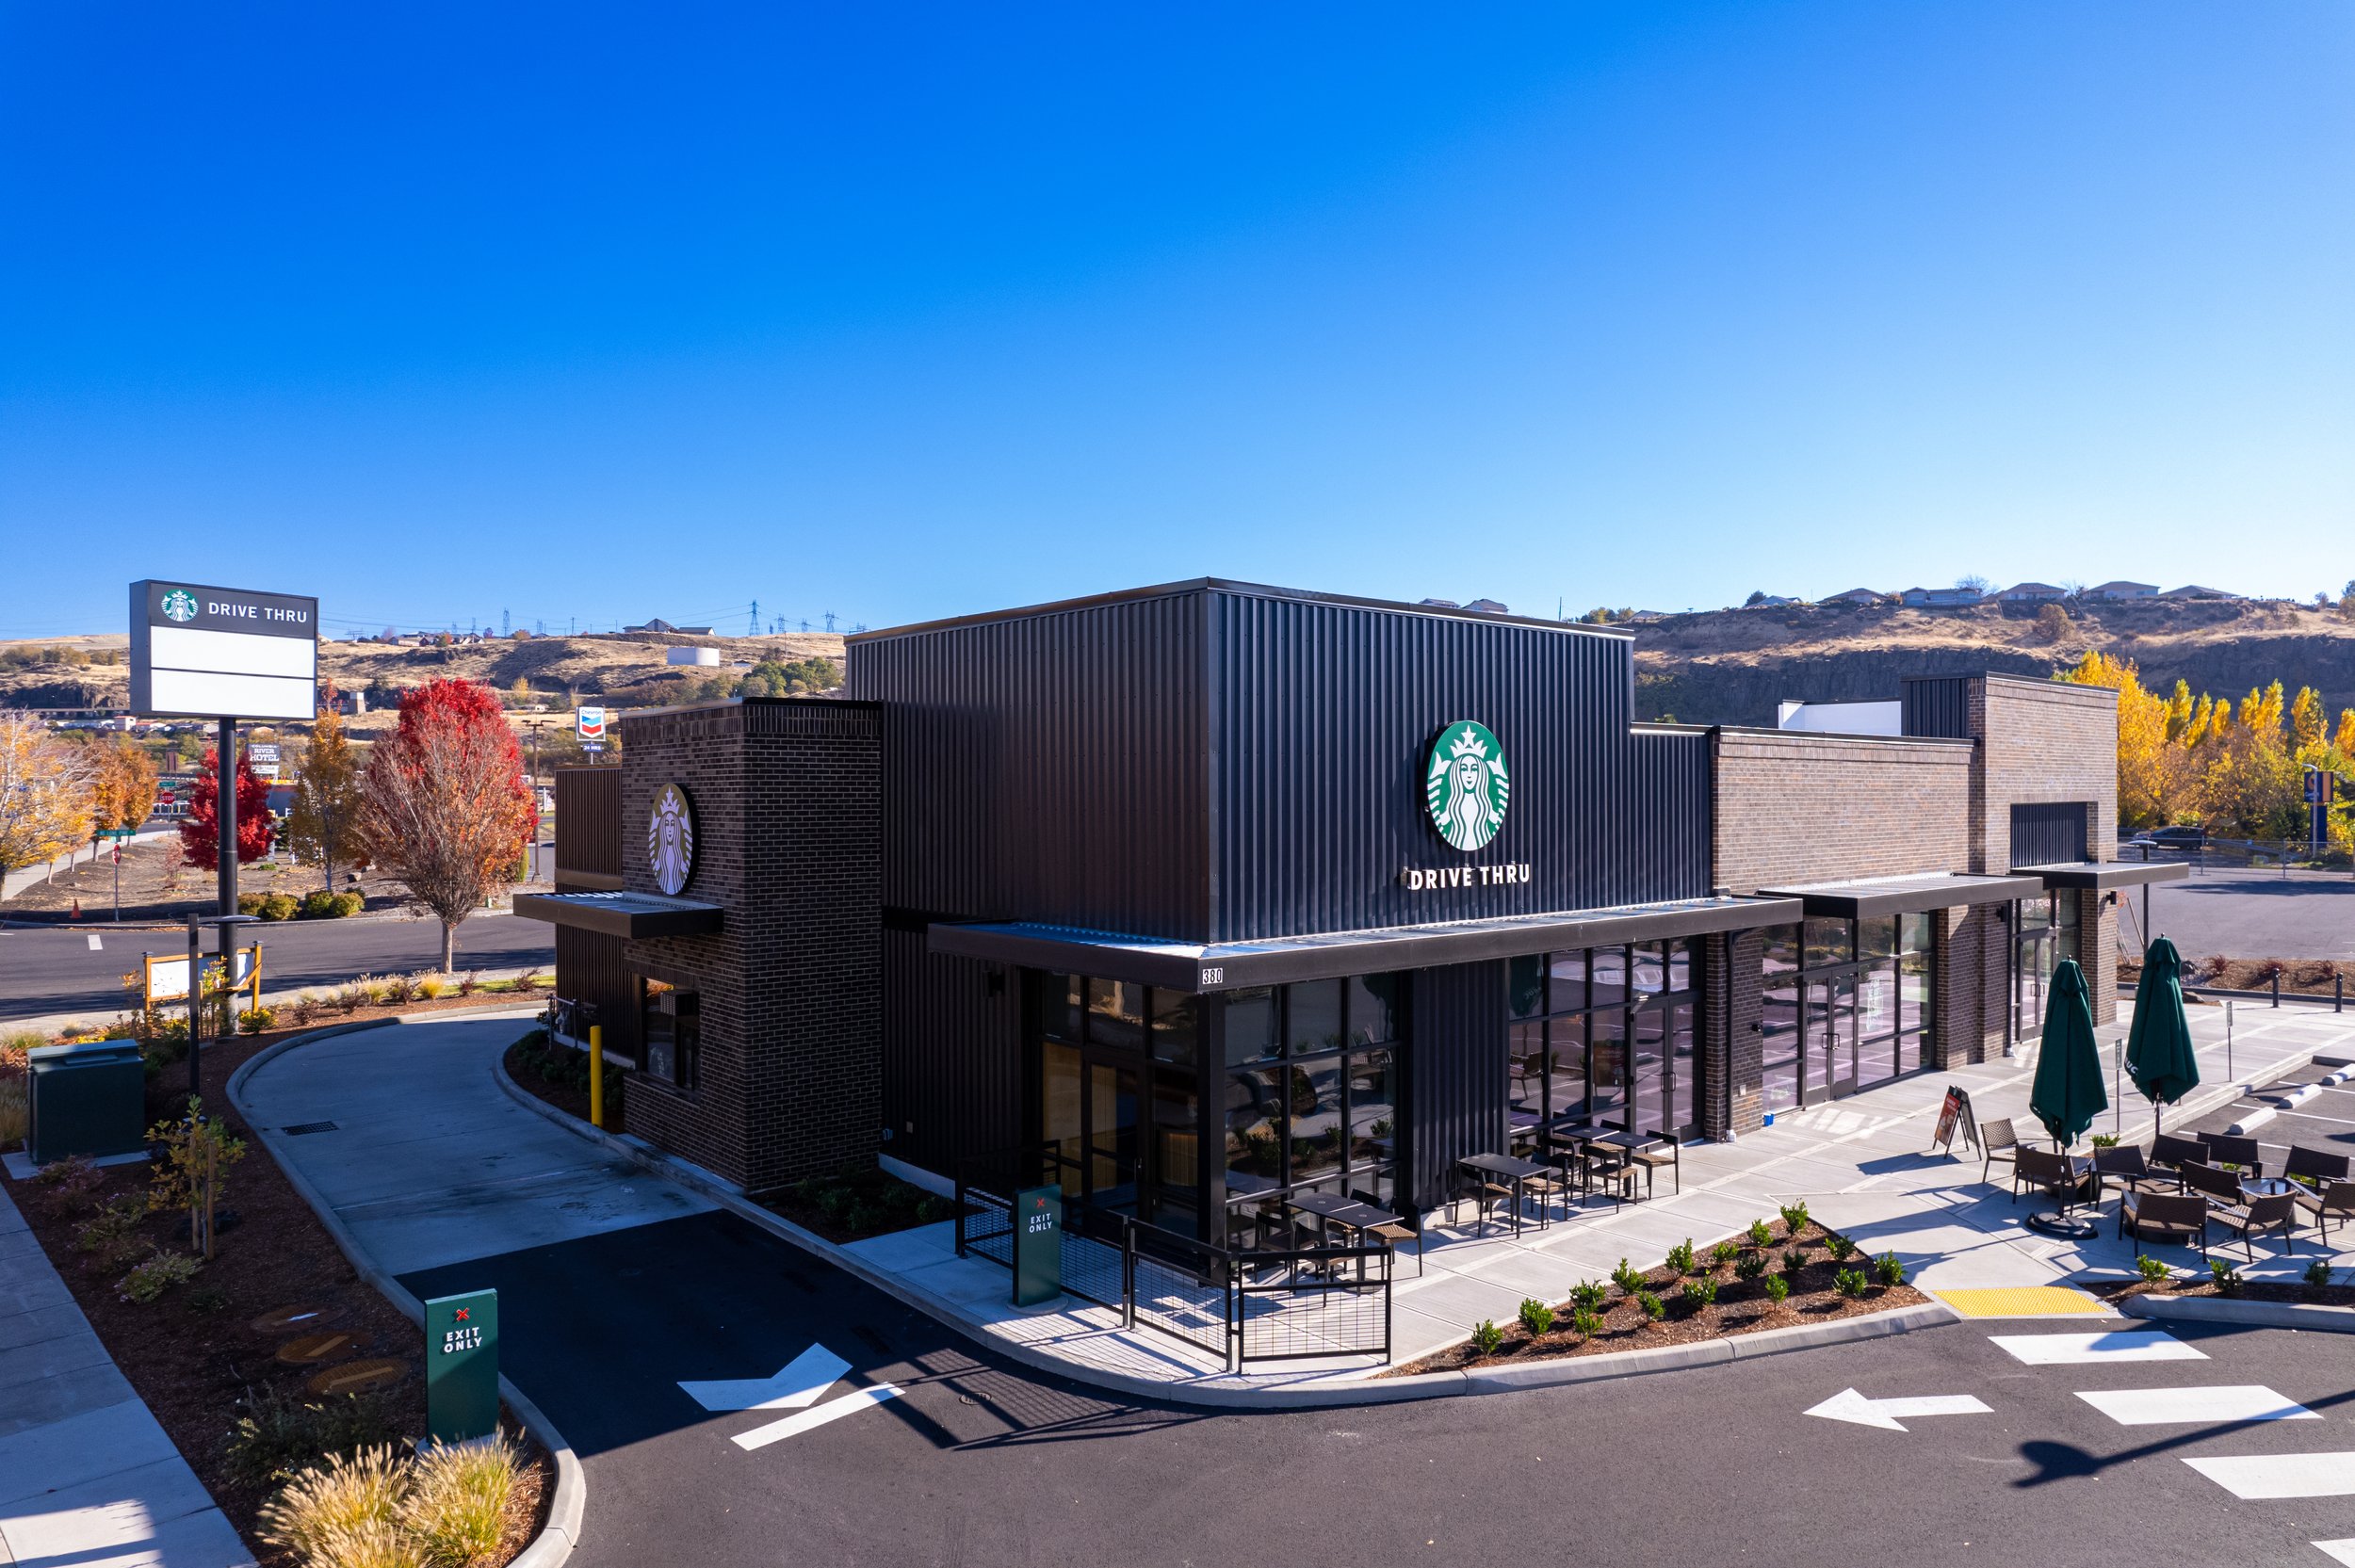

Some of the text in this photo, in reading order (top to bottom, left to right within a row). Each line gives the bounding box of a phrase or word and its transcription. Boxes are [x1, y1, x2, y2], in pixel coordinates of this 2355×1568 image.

[208, 602, 308, 623] DRIVE THRU
[1410, 864, 1530, 891] DRIVE THRU
[1203, 968, 1222, 984] 380
[1030, 1212, 1051, 1224] EXIT
[1029, 1221, 1052, 1233] ONLY
[446, 1326, 480, 1342] EXIT
[443, 1336, 483, 1353] ONLY
